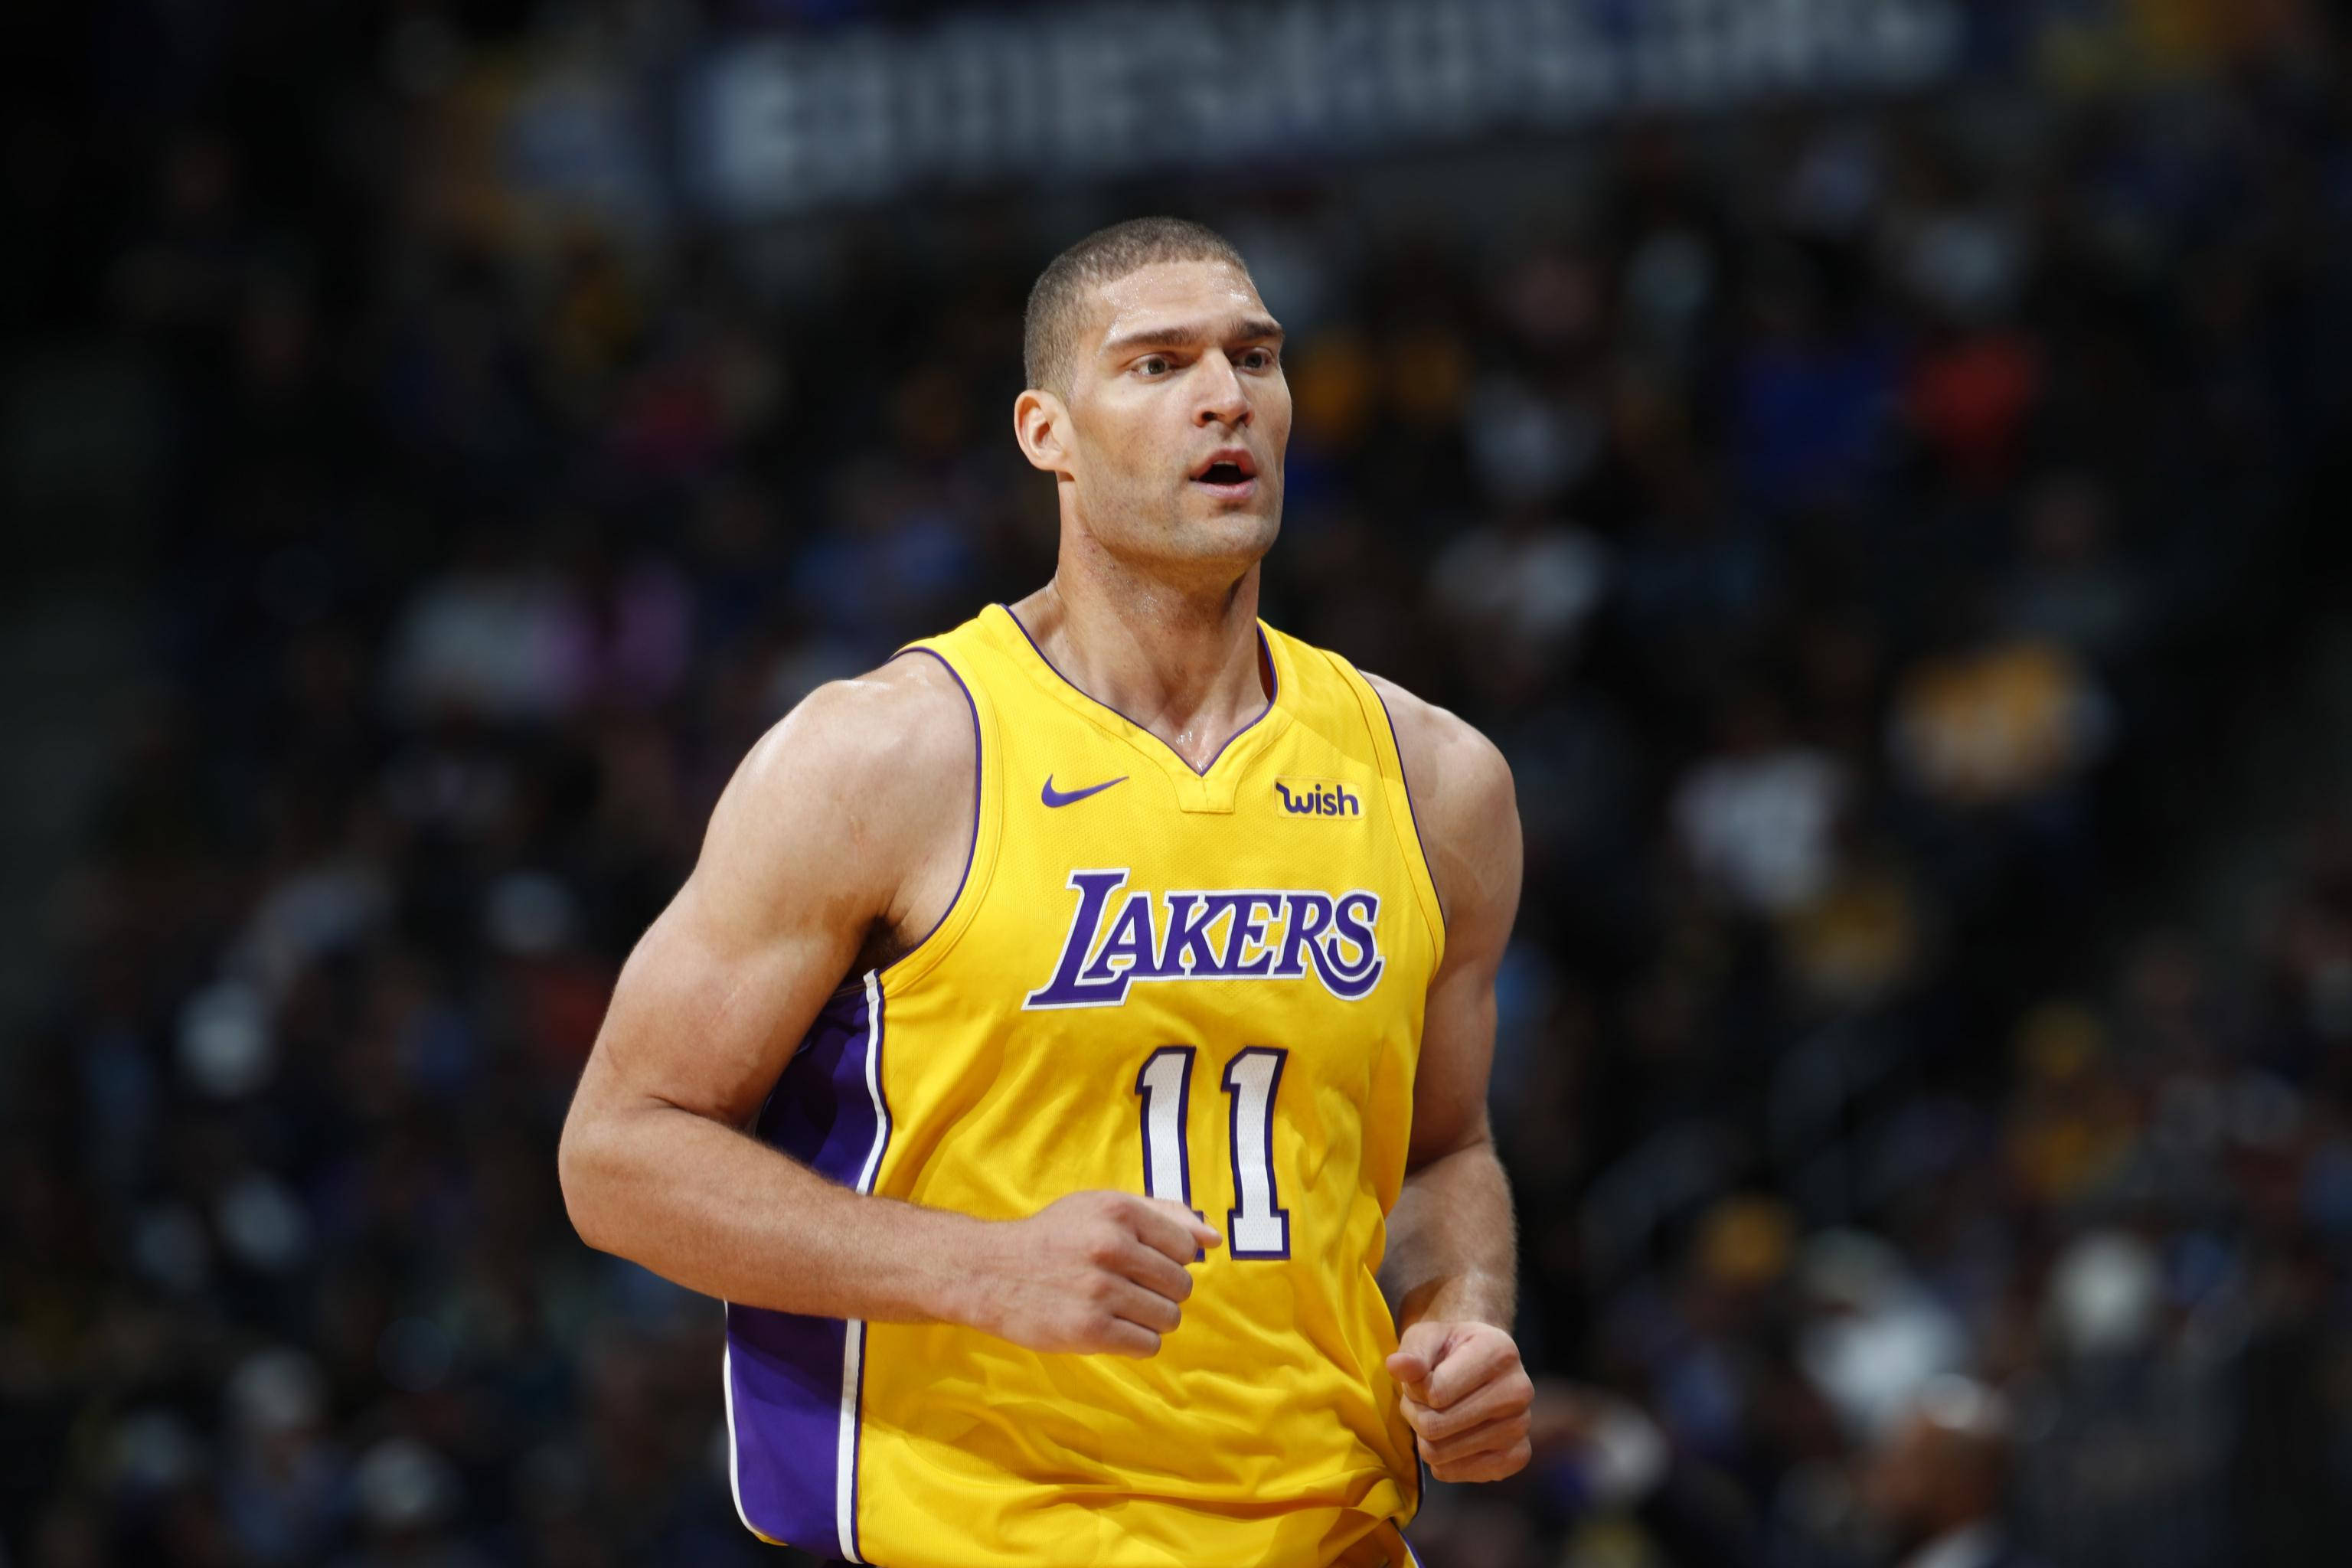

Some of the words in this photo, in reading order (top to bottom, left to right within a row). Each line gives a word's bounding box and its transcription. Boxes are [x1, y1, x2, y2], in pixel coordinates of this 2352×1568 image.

[1276, 782, 1359, 815] wish
[1021, 867, 1386, 1011] LAKERS
[1135, 1046, 1291, 1262] 11
